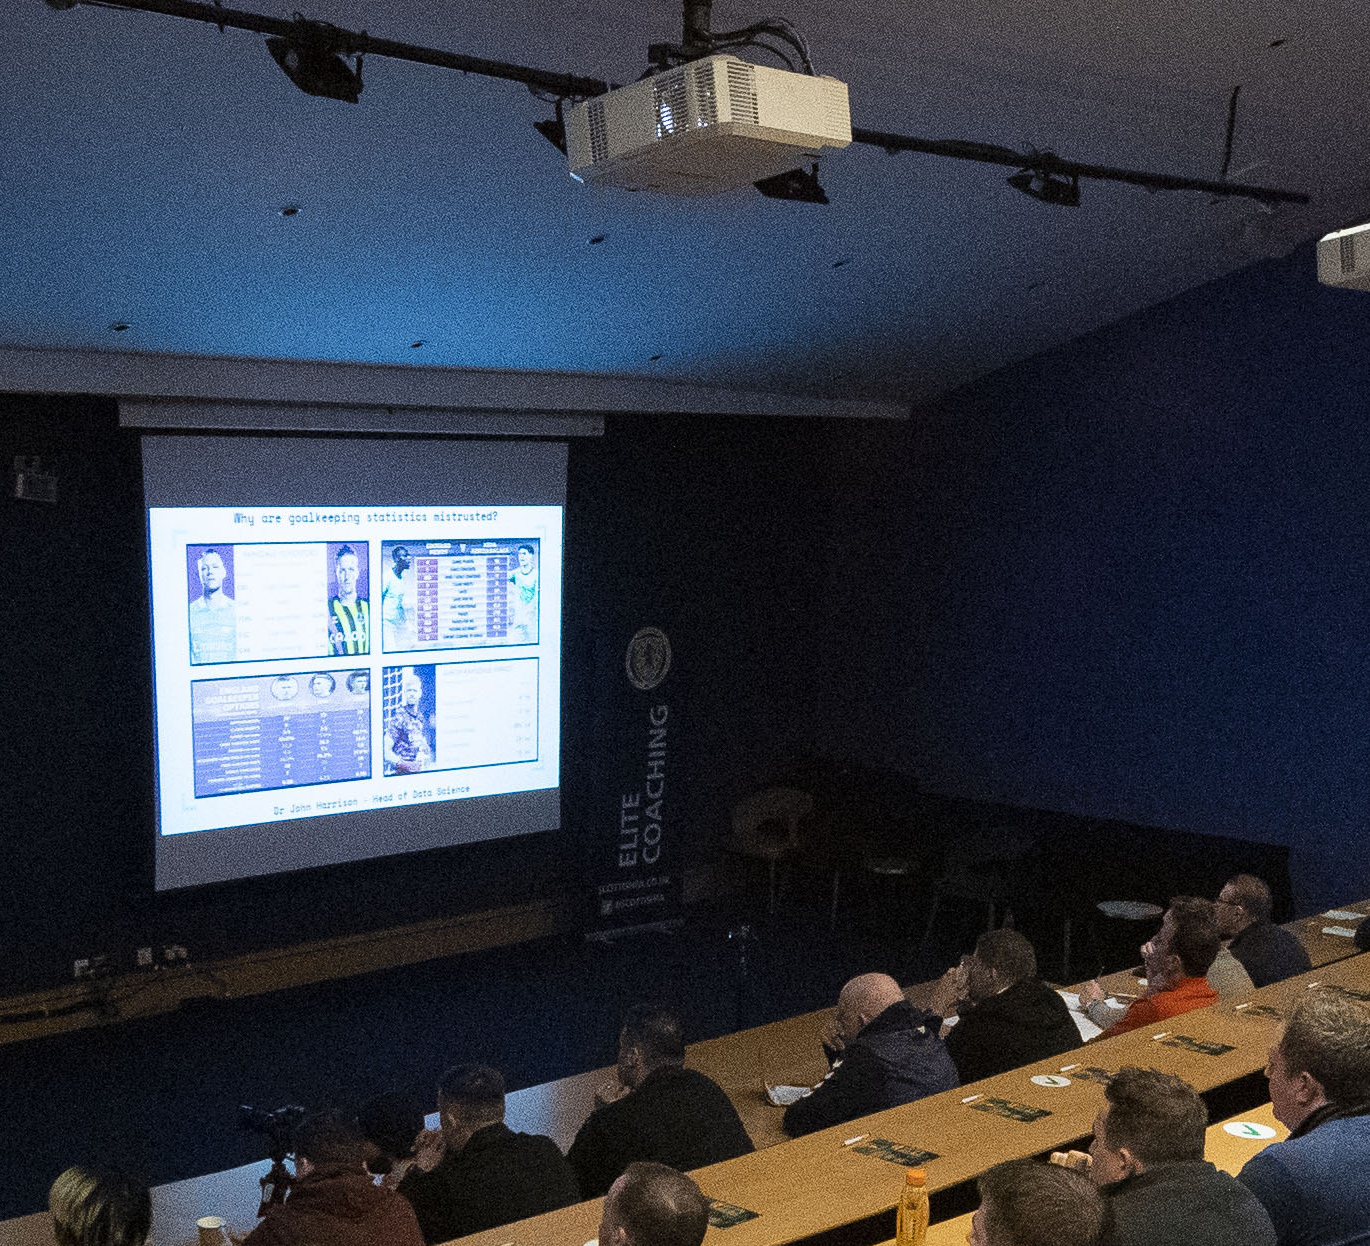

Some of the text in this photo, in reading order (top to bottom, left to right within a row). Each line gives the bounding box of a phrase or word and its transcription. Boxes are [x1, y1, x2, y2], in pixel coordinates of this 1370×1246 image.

[233, 511, 499, 526] Why are goalkeeping statistics mistrusted?
[273, 806, 285, 816] Dr
[290, 803, 312, 814] John
[316, 799, 358, 811] Harrison
[372, 793, 394, 804] Head
[397, 791, 408, 802] of
[413, 788, 433, 799] Data
[437, 785, 471, 797] Science
[642, 704, 670, 864] COACHING
[618, 792, 641, 868] ELITE
